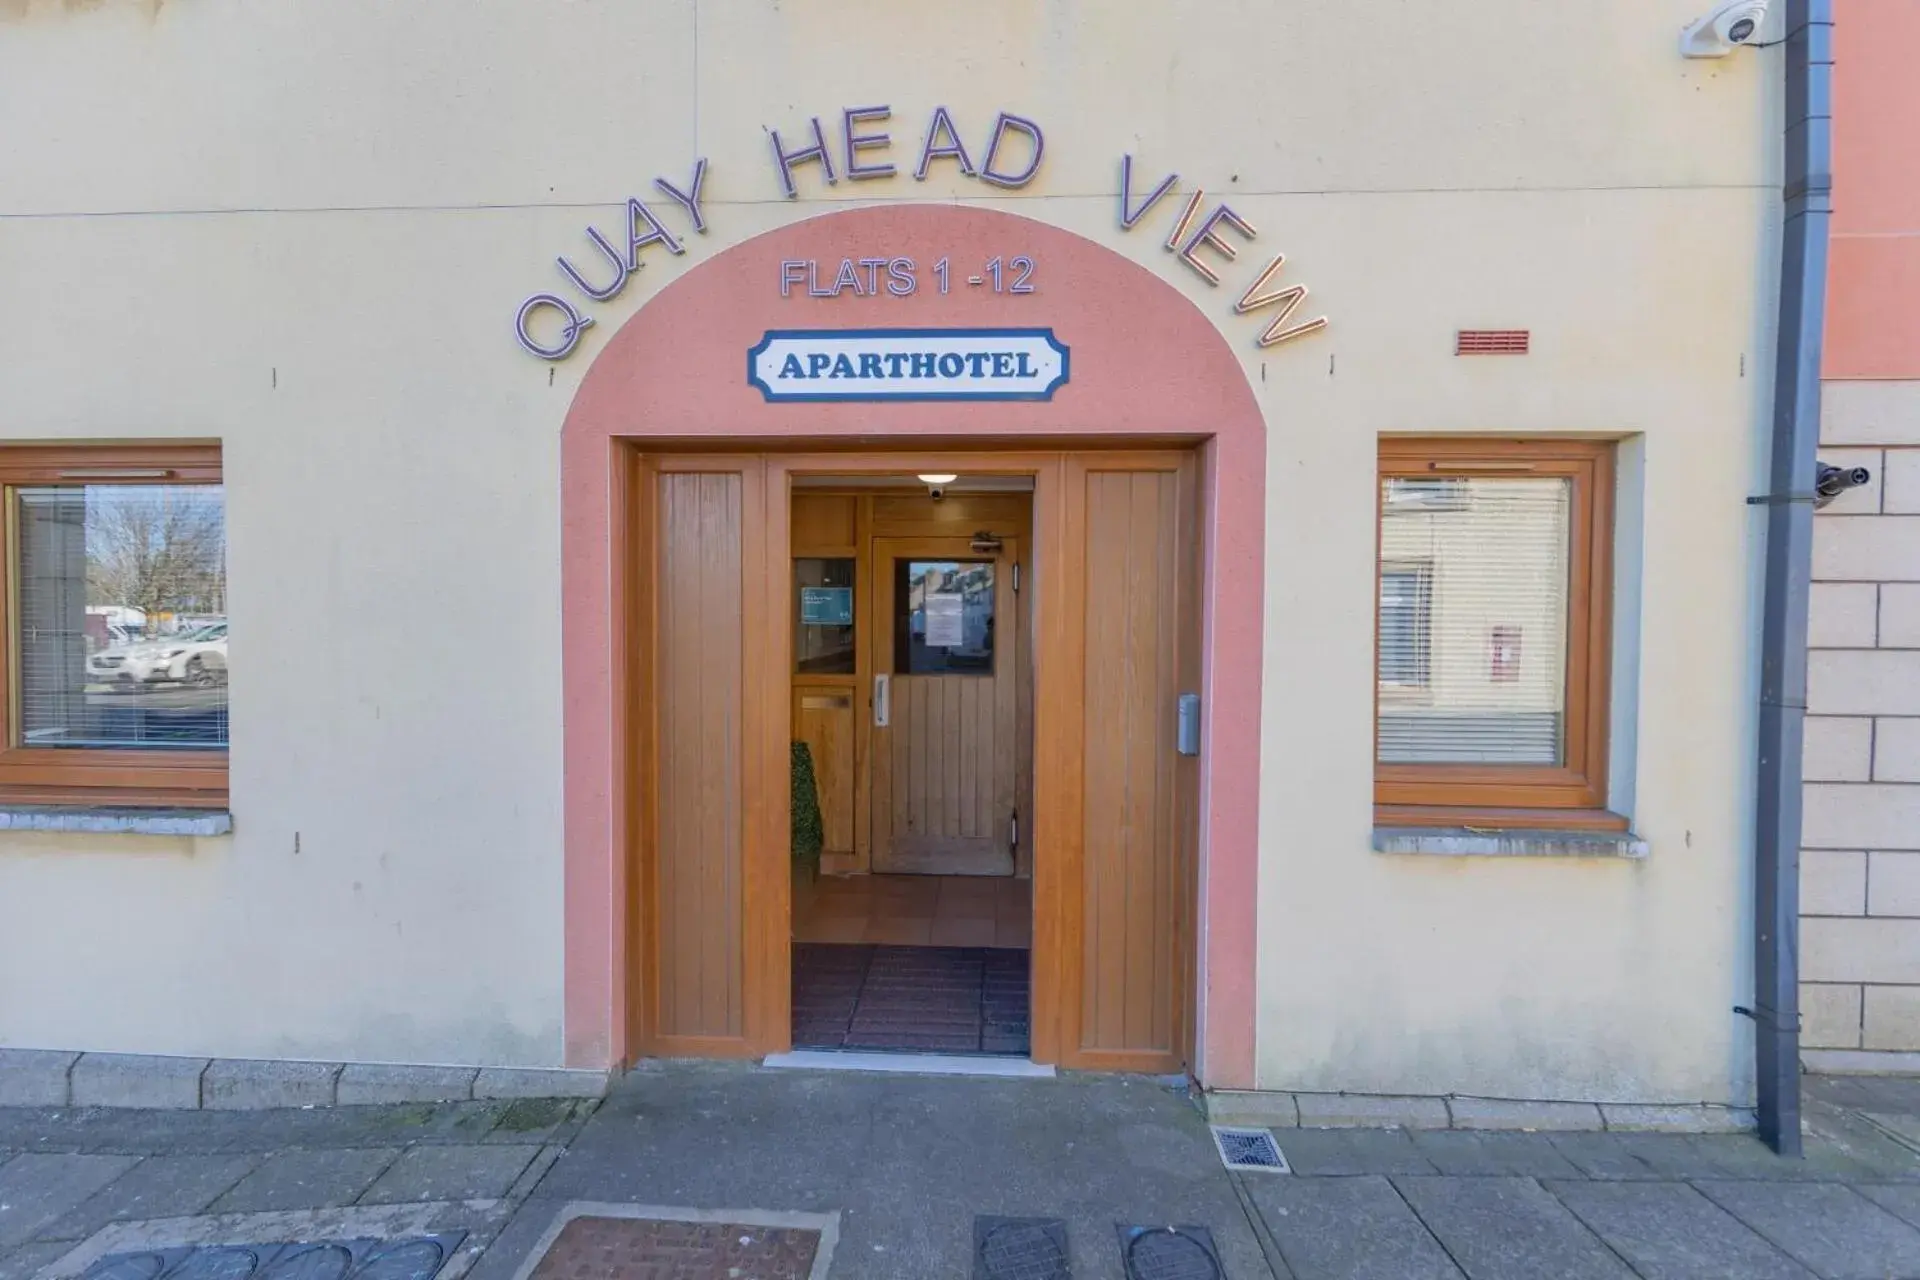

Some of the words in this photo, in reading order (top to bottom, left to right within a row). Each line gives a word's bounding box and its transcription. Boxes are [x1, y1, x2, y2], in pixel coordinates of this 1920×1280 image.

[514, 157, 708, 360] QUAY
[769, 104, 1045, 199] HEAD
[1120, 152, 1329, 347] VIEW
[780, 256, 917, 297] FLATS
[933, 256, 949, 295] 1
[777, 351, 1039, 380] APARTHOTEL
